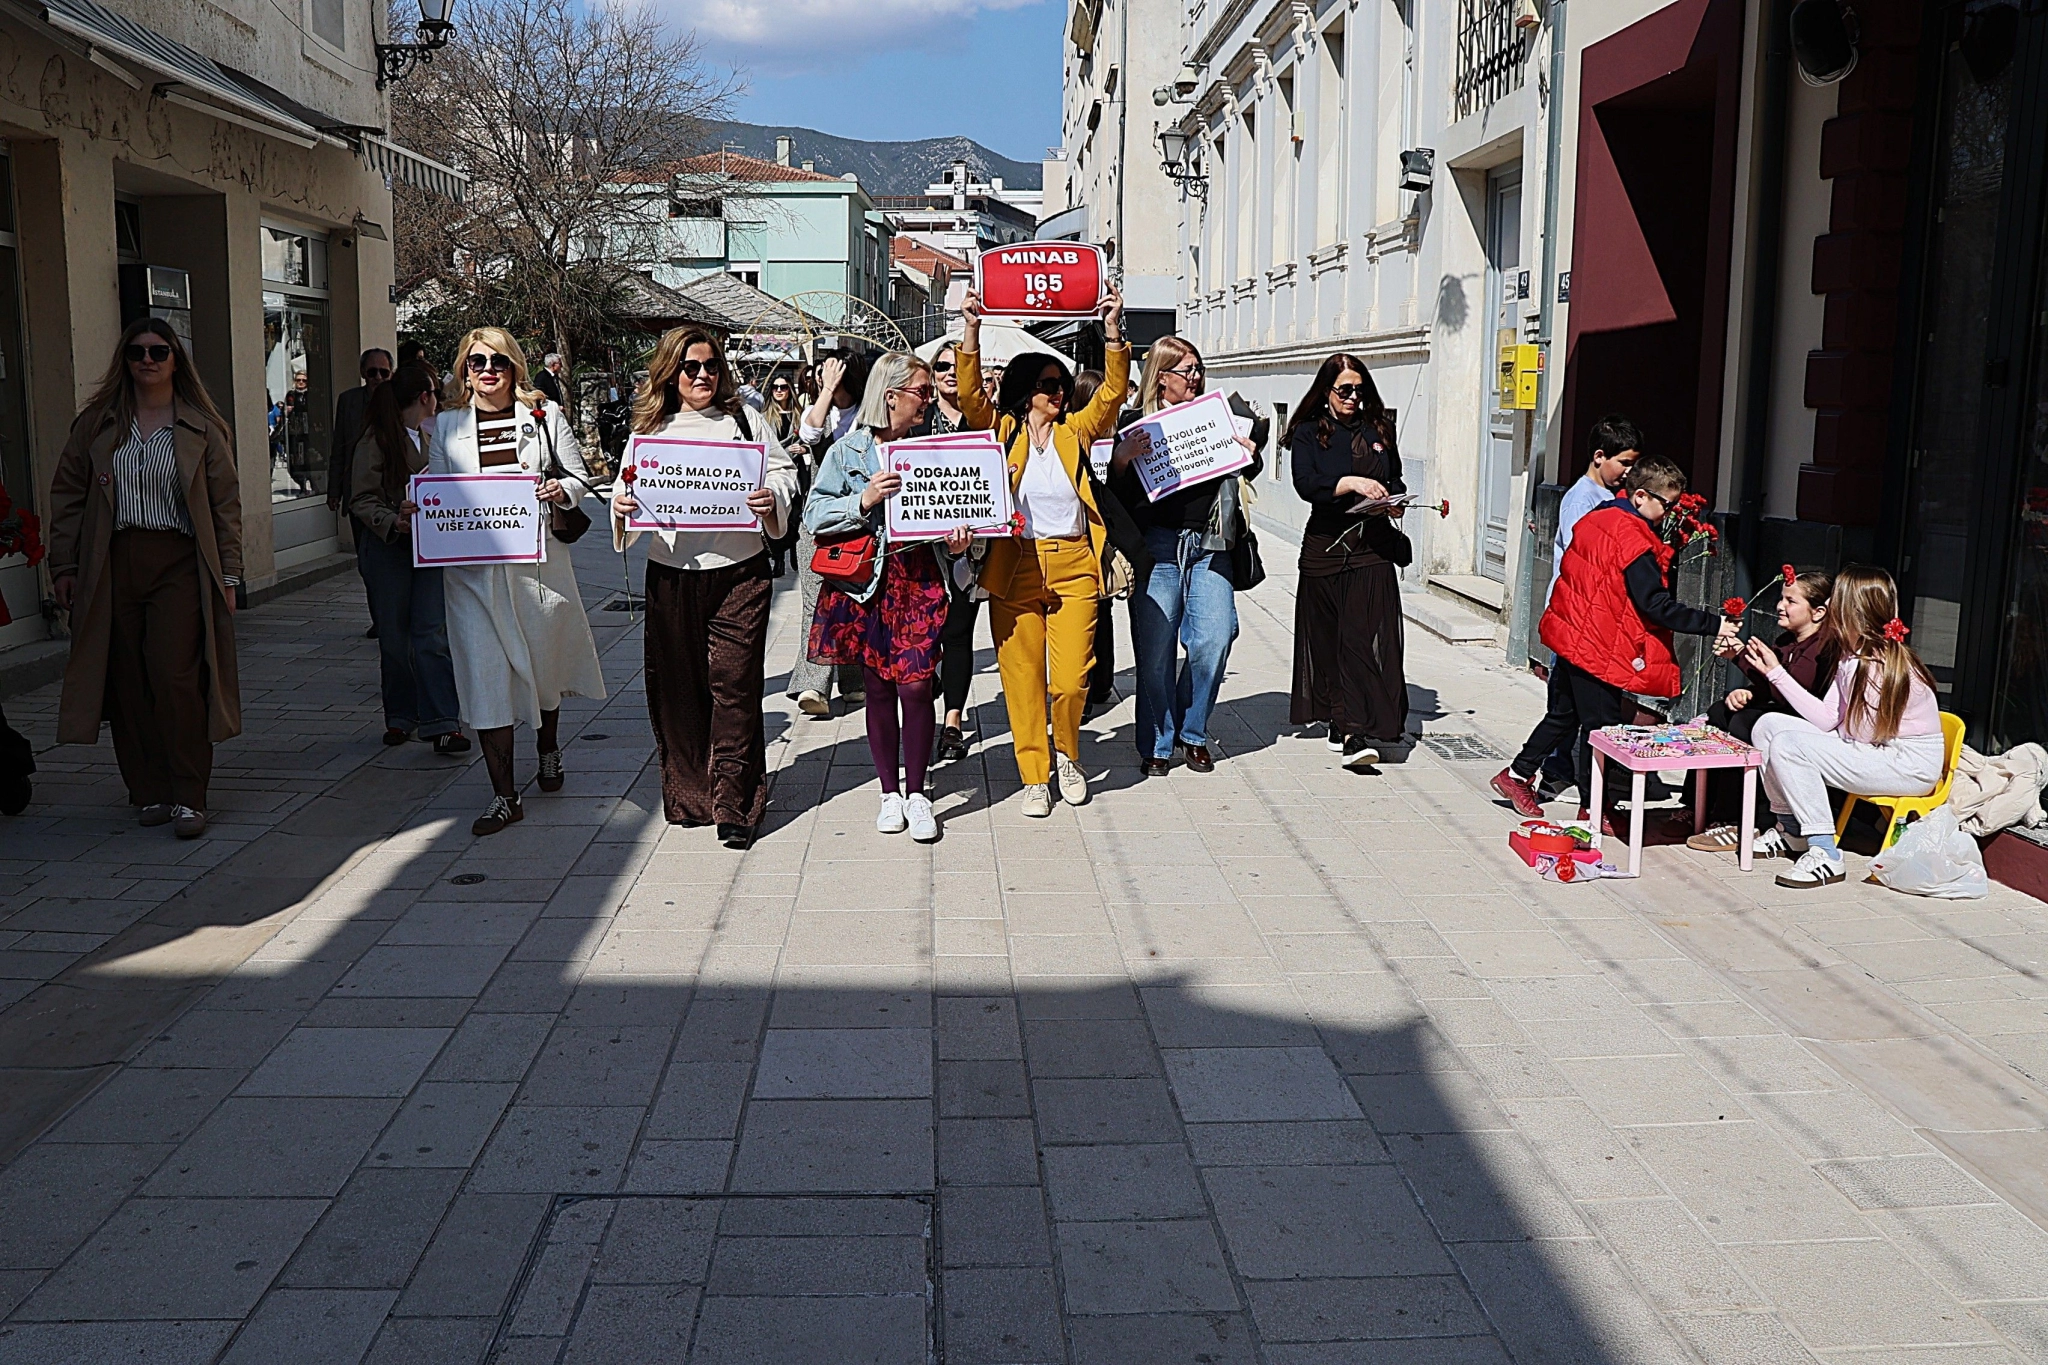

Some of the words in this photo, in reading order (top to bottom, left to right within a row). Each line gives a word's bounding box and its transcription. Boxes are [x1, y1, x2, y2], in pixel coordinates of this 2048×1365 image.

[1001, 251, 1079, 264] MINAB
[1023, 273, 1063, 292] 165
[1520, 272, 1528, 287] 43
[1561, 273, 1570, 289] 45
[1153, 428, 1194, 449] DOZVOLI
[1194, 425, 1208, 434] da
[1208, 419, 1216, 429] ti
[1143, 447, 1173, 466] buket
[1174, 435, 1207, 452] cvijeća
[1148, 453, 1183, 475] zatvori
[1184, 448, 1204, 460] usta
[1209, 437, 1234, 451] volju
[658, 463, 683, 476] JOŠ
[686, 467, 722, 478] MALO
[725, 469, 742, 479] PA
[913, 466, 981, 478] ODGAJAM
[1153, 474, 1166, 485] za
[1166, 455, 1215, 478] djelovanje
[640, 478, 758, 492] RAVNOPRAVNOST.
[906, 481, 938, 492] SINA
[940, 480, 970, 491] KOJI
[973, 476, 990, 491] ĆE
[901, 495, 926, 506] BITI
[928, 493, 995, 506] SAVEZNIK,
[425, 508, 470, 519] MANJE
[472, 504, 532, 517] CVIJEĆA,
[655, 503, 687, 514] 2124.
[690, 504, 740, 515] MOŽDA!
[901, 509, 911, 520] A
[914, 509, 931, 520] NE
[933, 507, 997, 519] NASILNIK.
[436, 519, 465, 532] VIŠE
[467, 519, 525, 531] ZAKONA.
